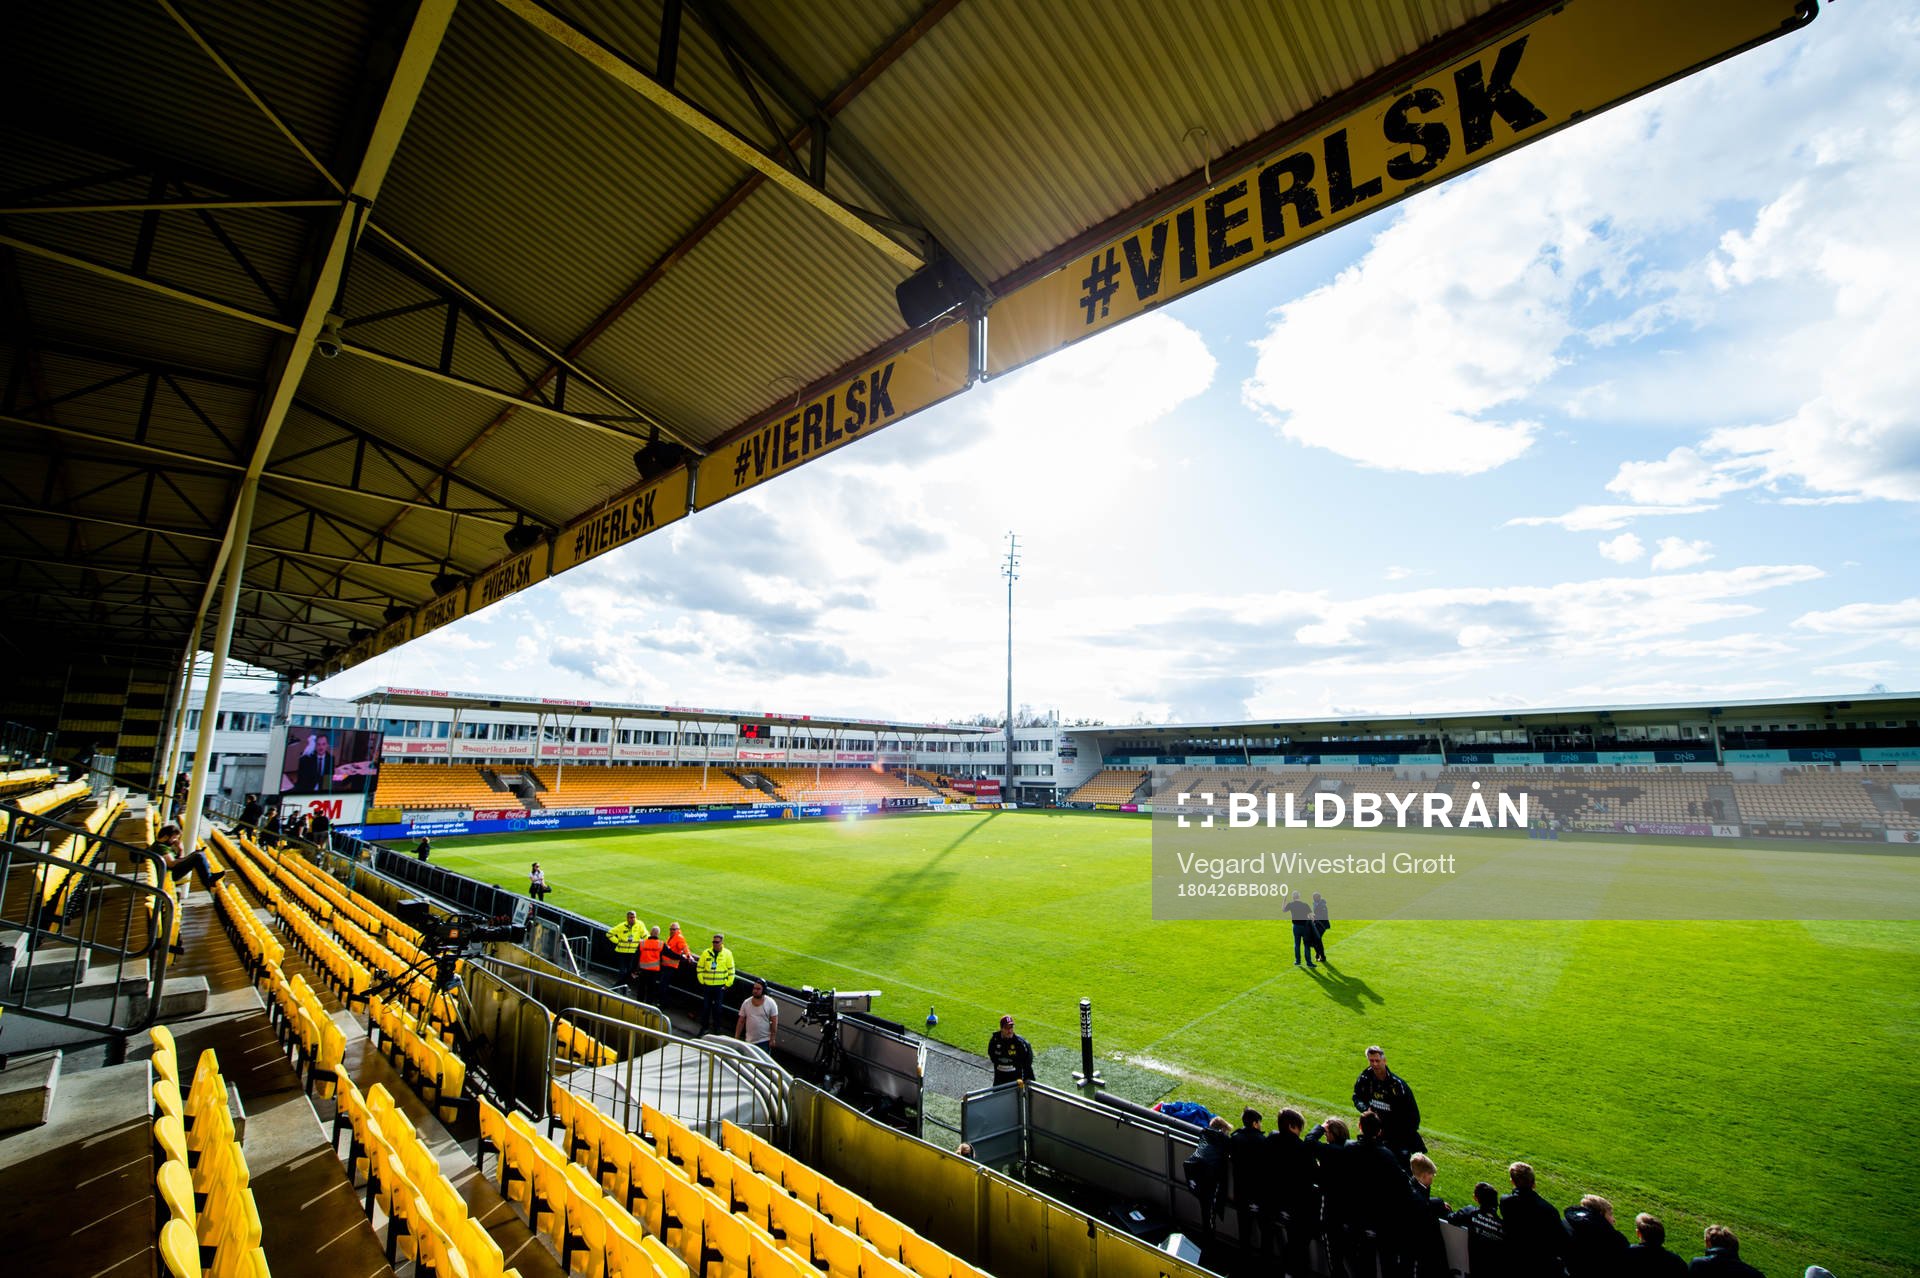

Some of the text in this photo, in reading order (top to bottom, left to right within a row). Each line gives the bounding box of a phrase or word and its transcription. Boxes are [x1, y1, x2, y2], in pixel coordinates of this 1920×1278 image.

[1080, 33, 1547, 324] #VIERLSK
[733, 362, 896, 487] #VIERLSK
[573, 488, 657, 561] #VIERLSK
[481, 554, 533, 604] #VIERLSK
[387, 687, 429, 696] Romerikes
[422, 744, 446, 752] rb.no
[1674, 752, 1696, 762] DNB
[308, 799, 342, 820] 3M
[528, 817, 560, 826] Nabohjelp
